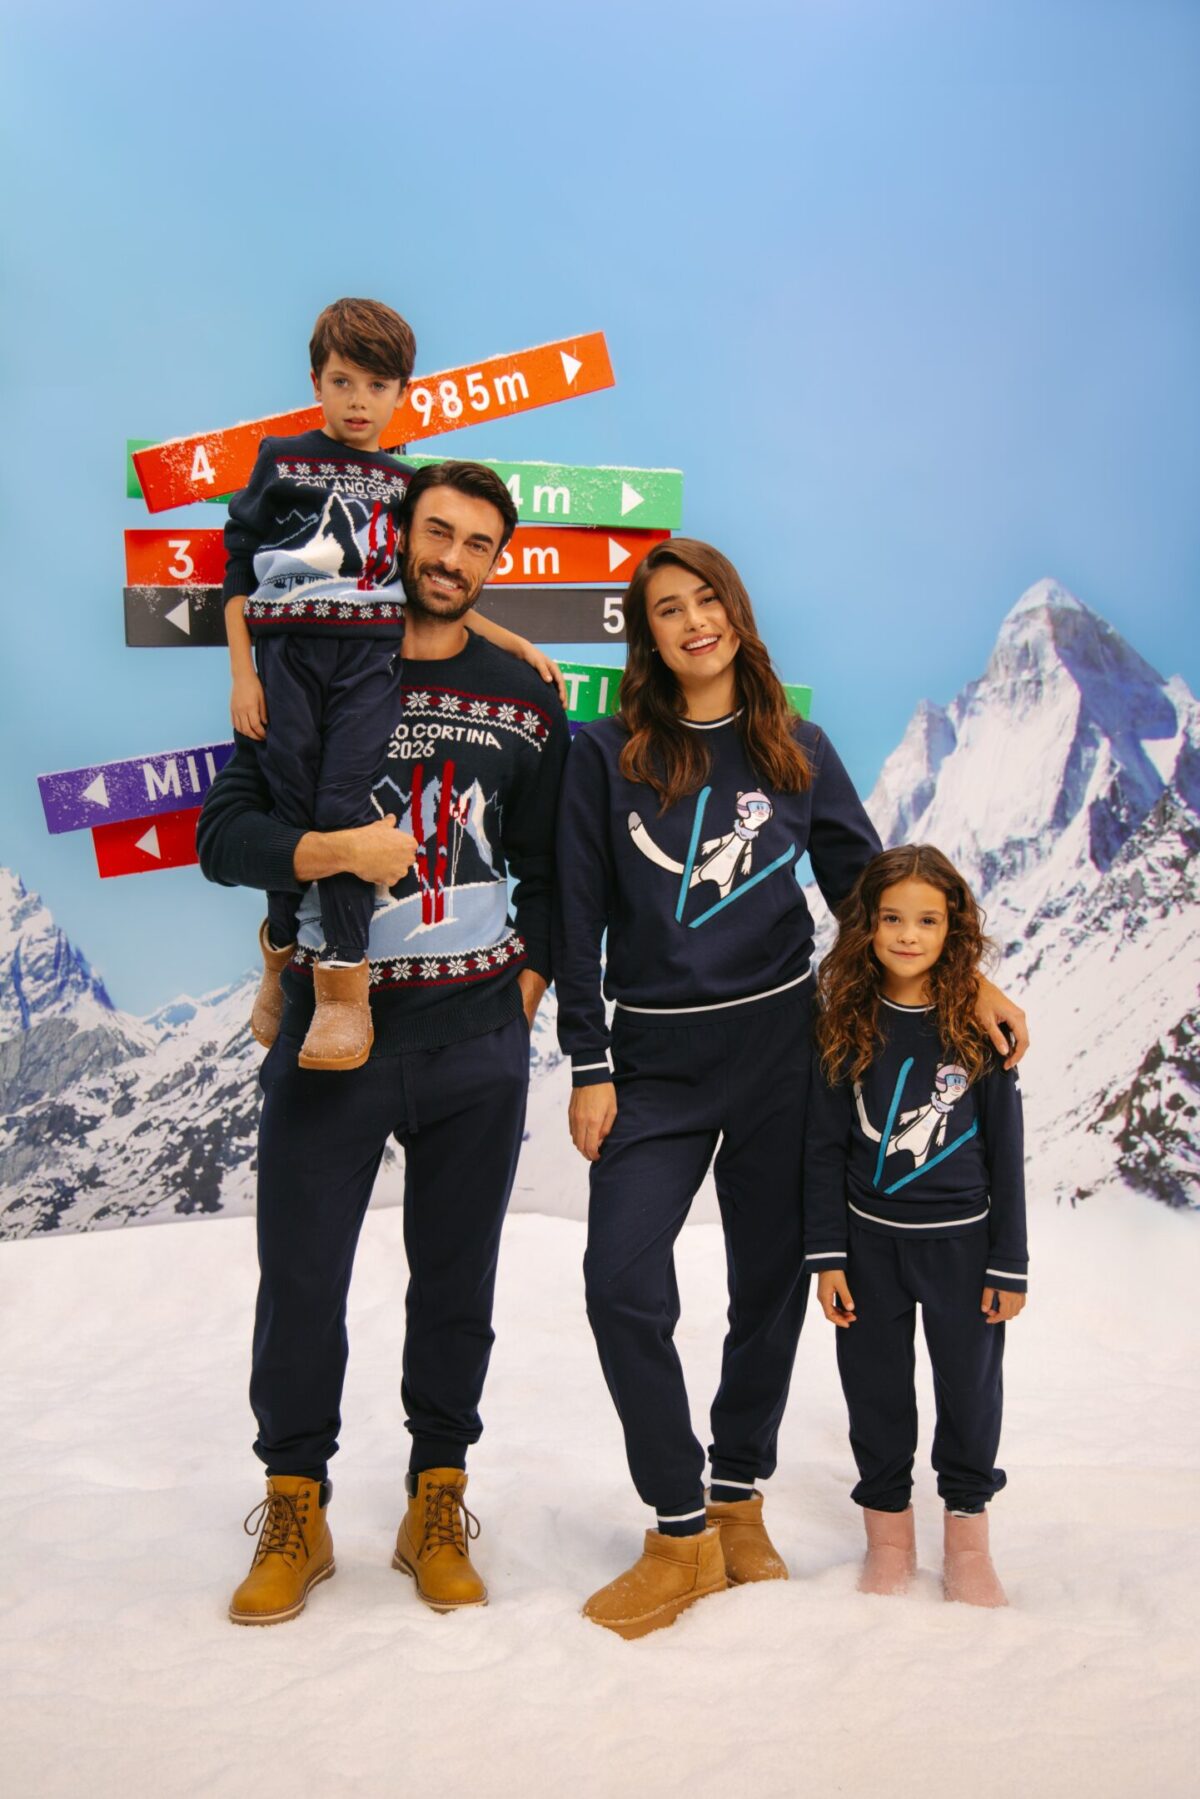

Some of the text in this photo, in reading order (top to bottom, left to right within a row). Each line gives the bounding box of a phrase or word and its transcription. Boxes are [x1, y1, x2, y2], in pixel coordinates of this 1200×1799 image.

[190, 371, 530, 485] 4 985m
[167, 540, 195, 579] 3
[603, 597, 625, 634] 5
[562, 673, 622, 714] TI
[387, 740, 436, 759] 2026
[390, 723, 503, 751] O CORTINA
